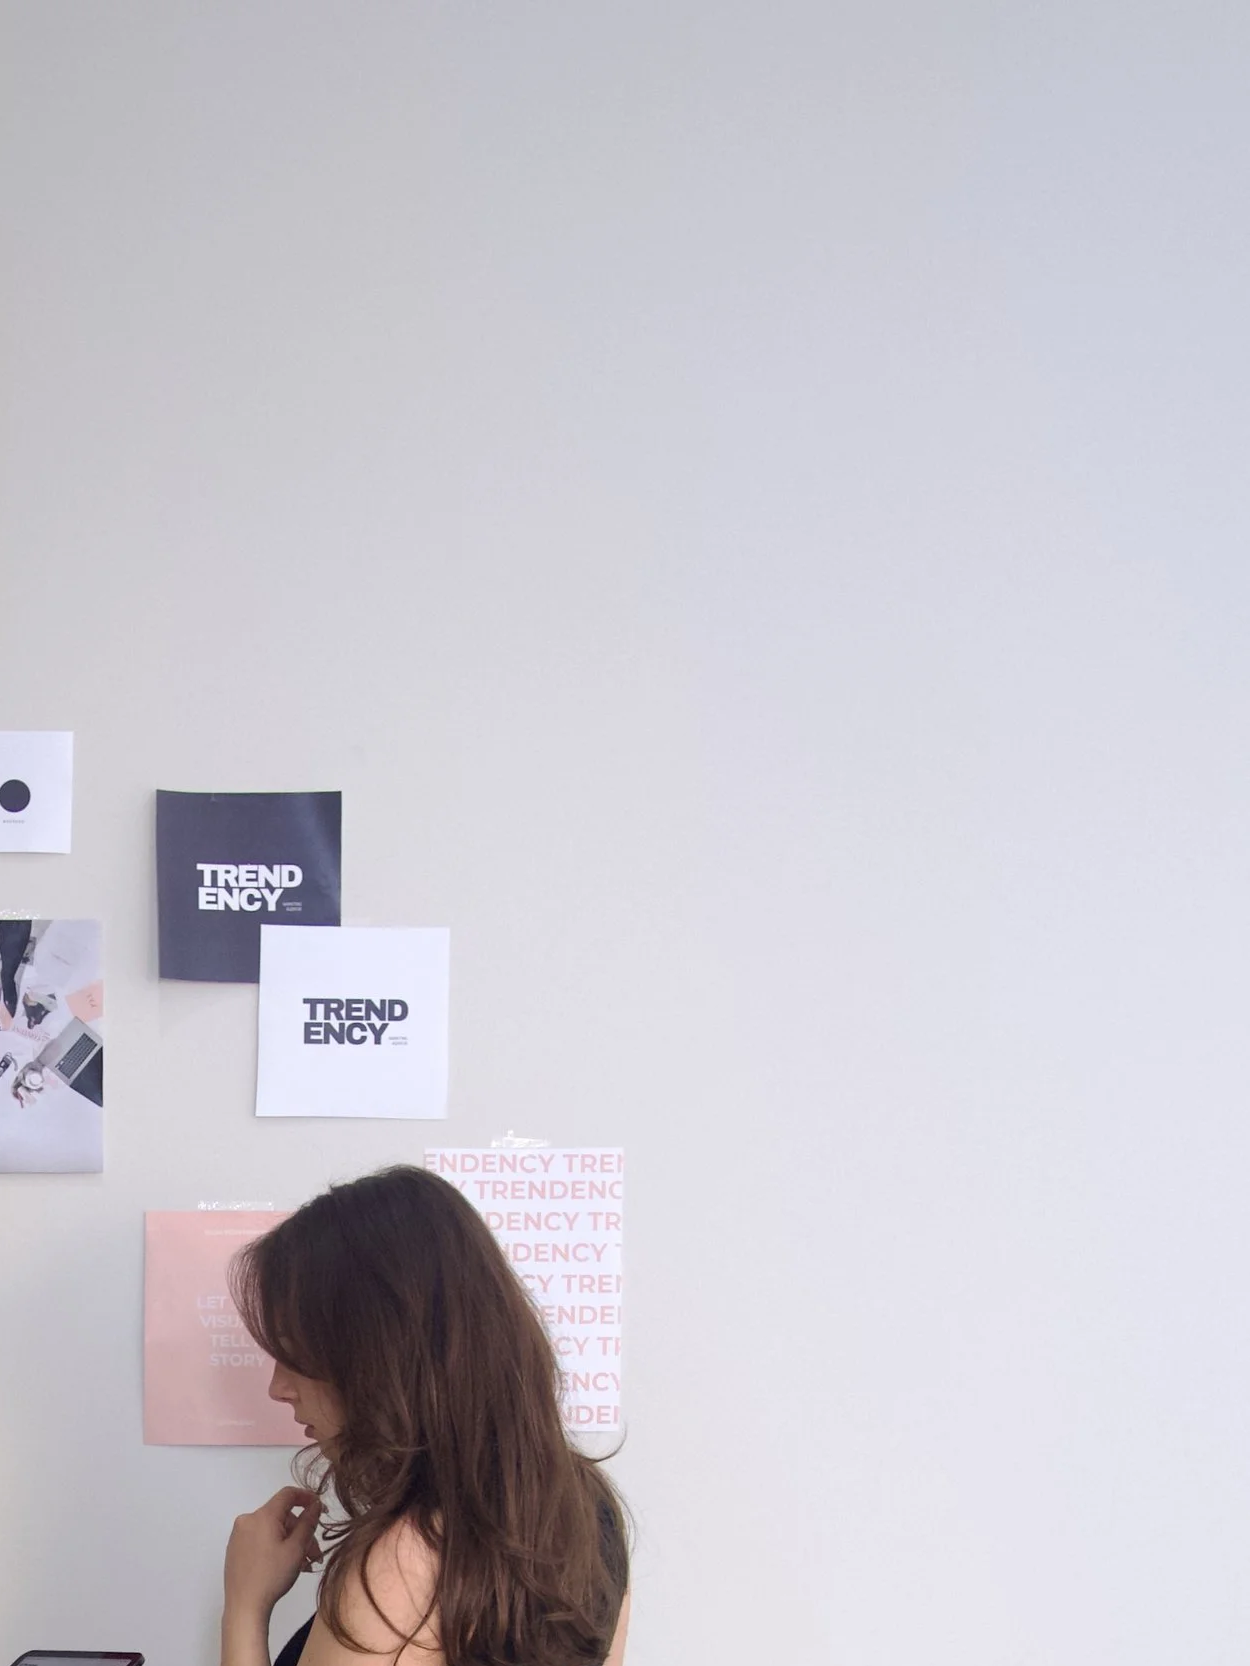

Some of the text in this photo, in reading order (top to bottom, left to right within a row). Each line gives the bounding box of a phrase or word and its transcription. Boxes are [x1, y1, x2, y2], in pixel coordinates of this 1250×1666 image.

[196, 863, 303, 888] TREND
[198, 887, 284, 912] ENCY
[303, 998, 409, 1021] TREND
[304, 1022, 390, 1045] ENCY
[505, 1243, 608, 1262] DENCY
[196, 1296, 226, 1309] LET
[210, 1353, 267, 1368] STORY
